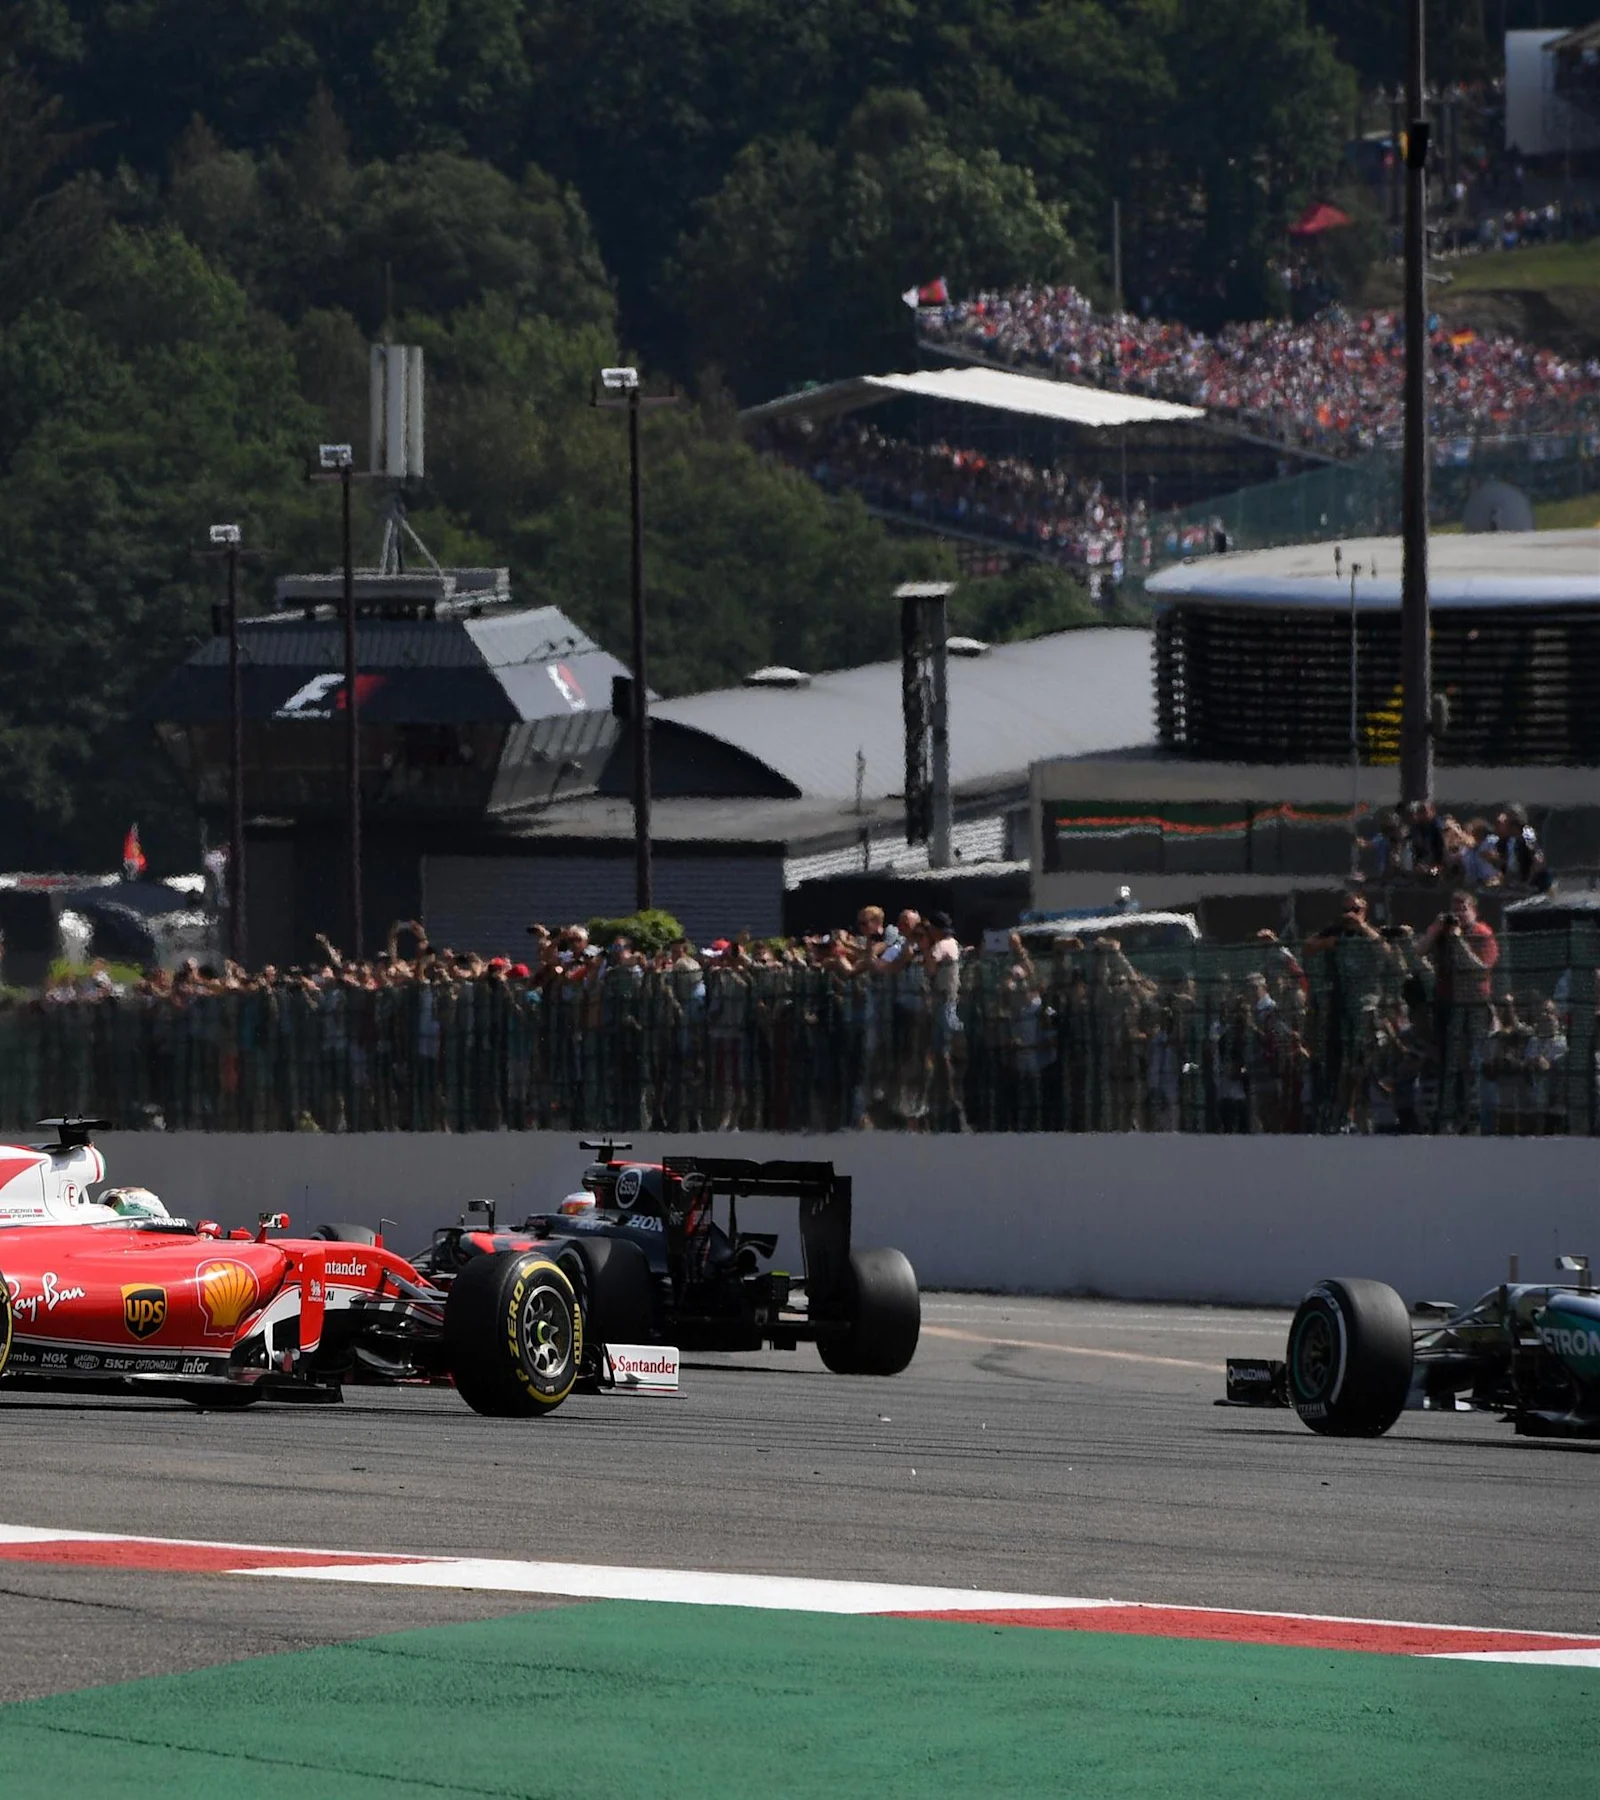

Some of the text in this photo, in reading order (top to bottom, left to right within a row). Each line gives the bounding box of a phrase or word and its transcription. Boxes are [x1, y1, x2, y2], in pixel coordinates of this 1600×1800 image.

[151, 1216, 188, 1228] HUBLOT
[507, 1279, 526, 1359] ZERO
[573, 1302, 584, 1366] PIRELLI
[41, 1352, 69, 1364] NGK
[103, 1358, 135, 1370] SKF
[182, 1357, 210, 1374] infor
[618, 1355, 677, 1374] Santander
